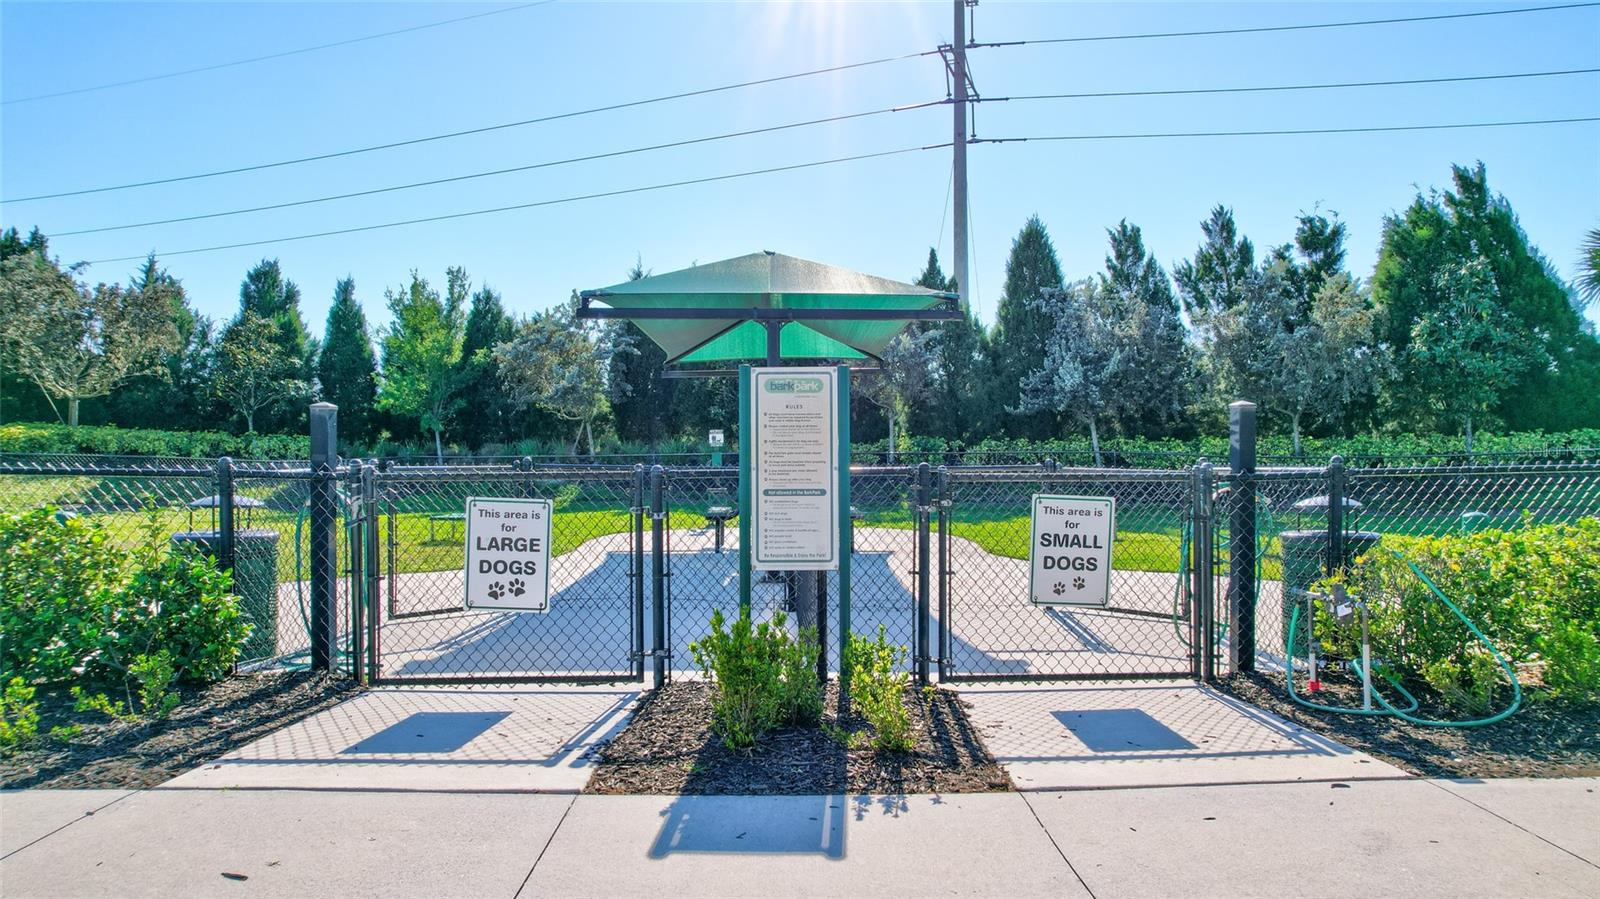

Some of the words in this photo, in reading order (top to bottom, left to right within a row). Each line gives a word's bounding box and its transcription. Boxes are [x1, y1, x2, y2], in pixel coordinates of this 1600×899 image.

[478, 508, 500, 519] This
[504, 512, 528, 520] area
[531, 510, 541, 520] is
[1043, 506, 1064, 516] This
[1067, 508, 1091, 516] area
[1094, 508, 1103, 517] is
[501, 523, 517, 532] for
[1064, 520, 1080, 529] for
[476, 536, 541, 552] LARGE
[1040, 532, 1103, 550] SMALL
[479, 560, 536, 576] DOGS
[1043, 556, 1098, 572] DOGS
